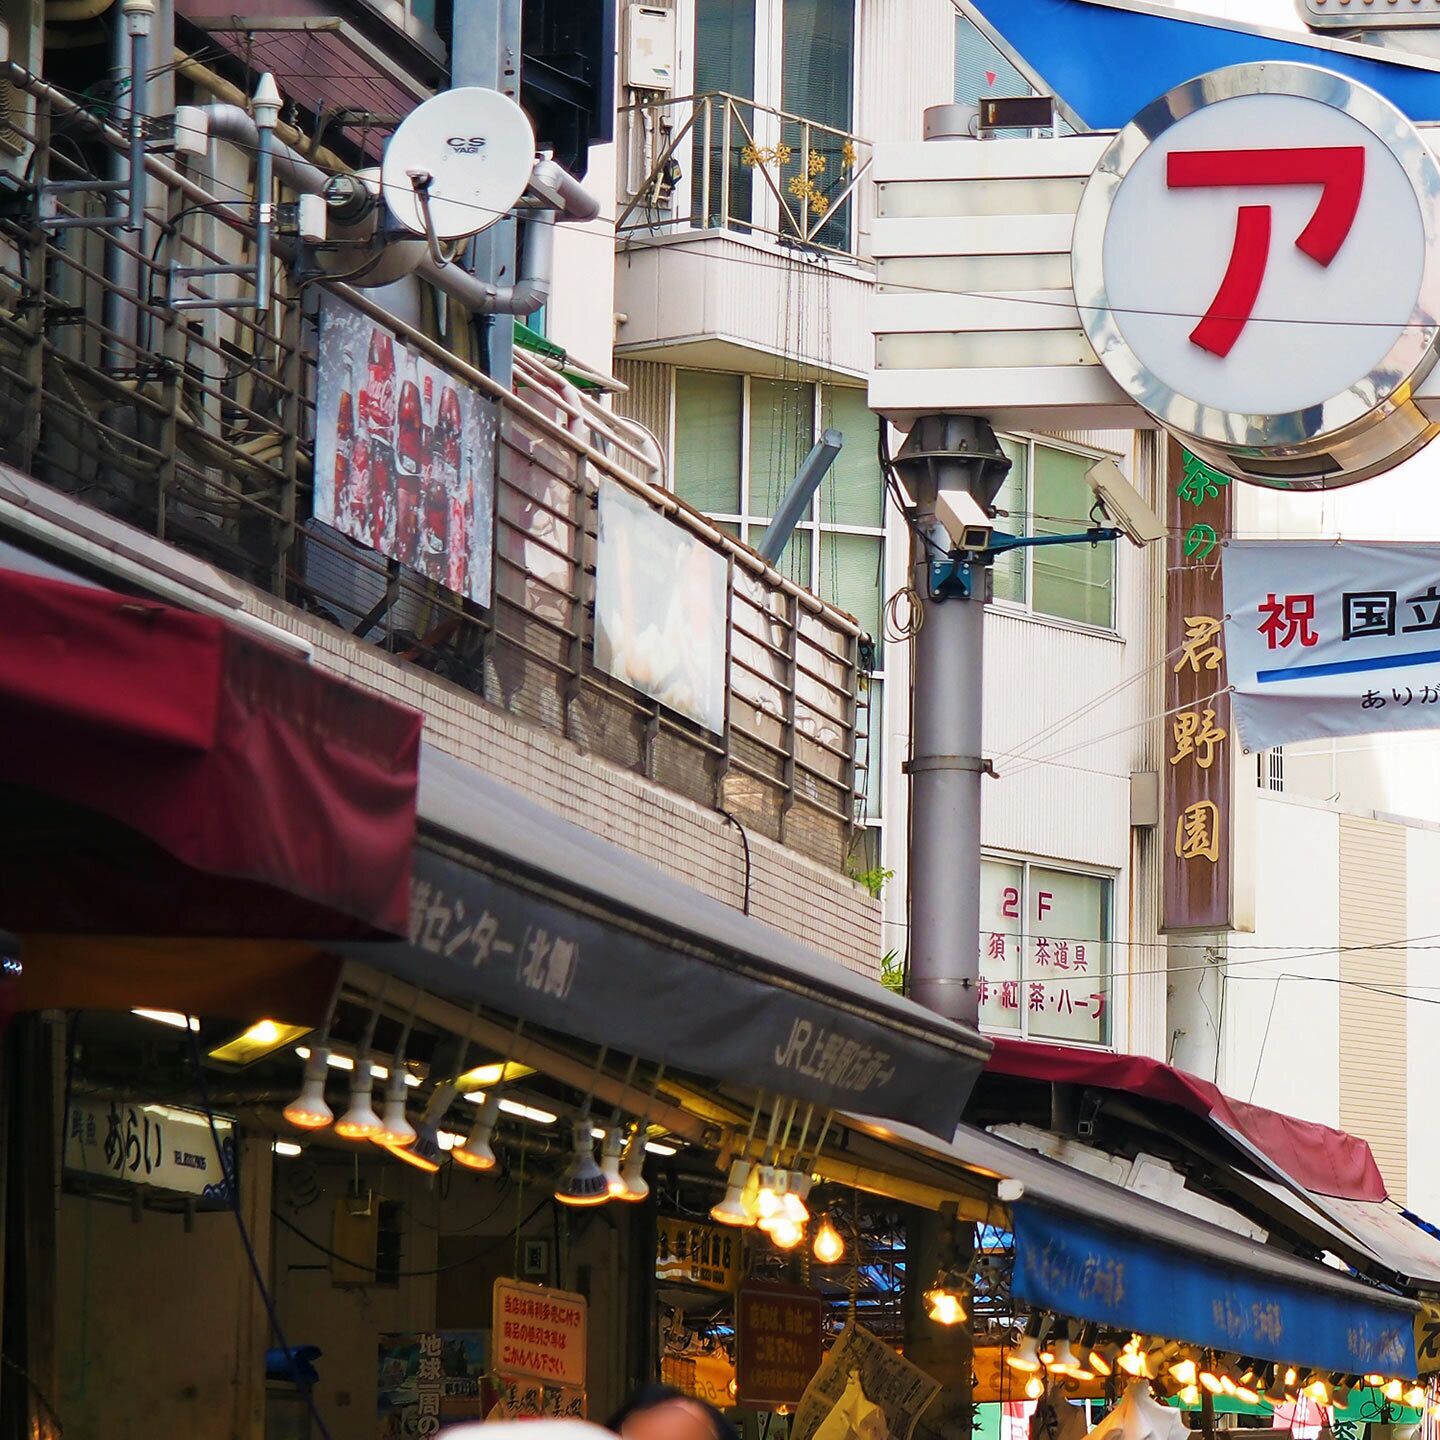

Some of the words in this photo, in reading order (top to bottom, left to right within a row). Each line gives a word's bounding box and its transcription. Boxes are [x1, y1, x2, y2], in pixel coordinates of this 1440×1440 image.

[446, 137, 486, 147] CS
[1256, 592, 1319, 650] 祝
[1168, 615, 1227, 863] 君野園
[979, 932, 1089, 973] 須・茶道具
[104, 1102, 162, 1175] あらい
[418, 1333, 441, 1440] 地球一周の
